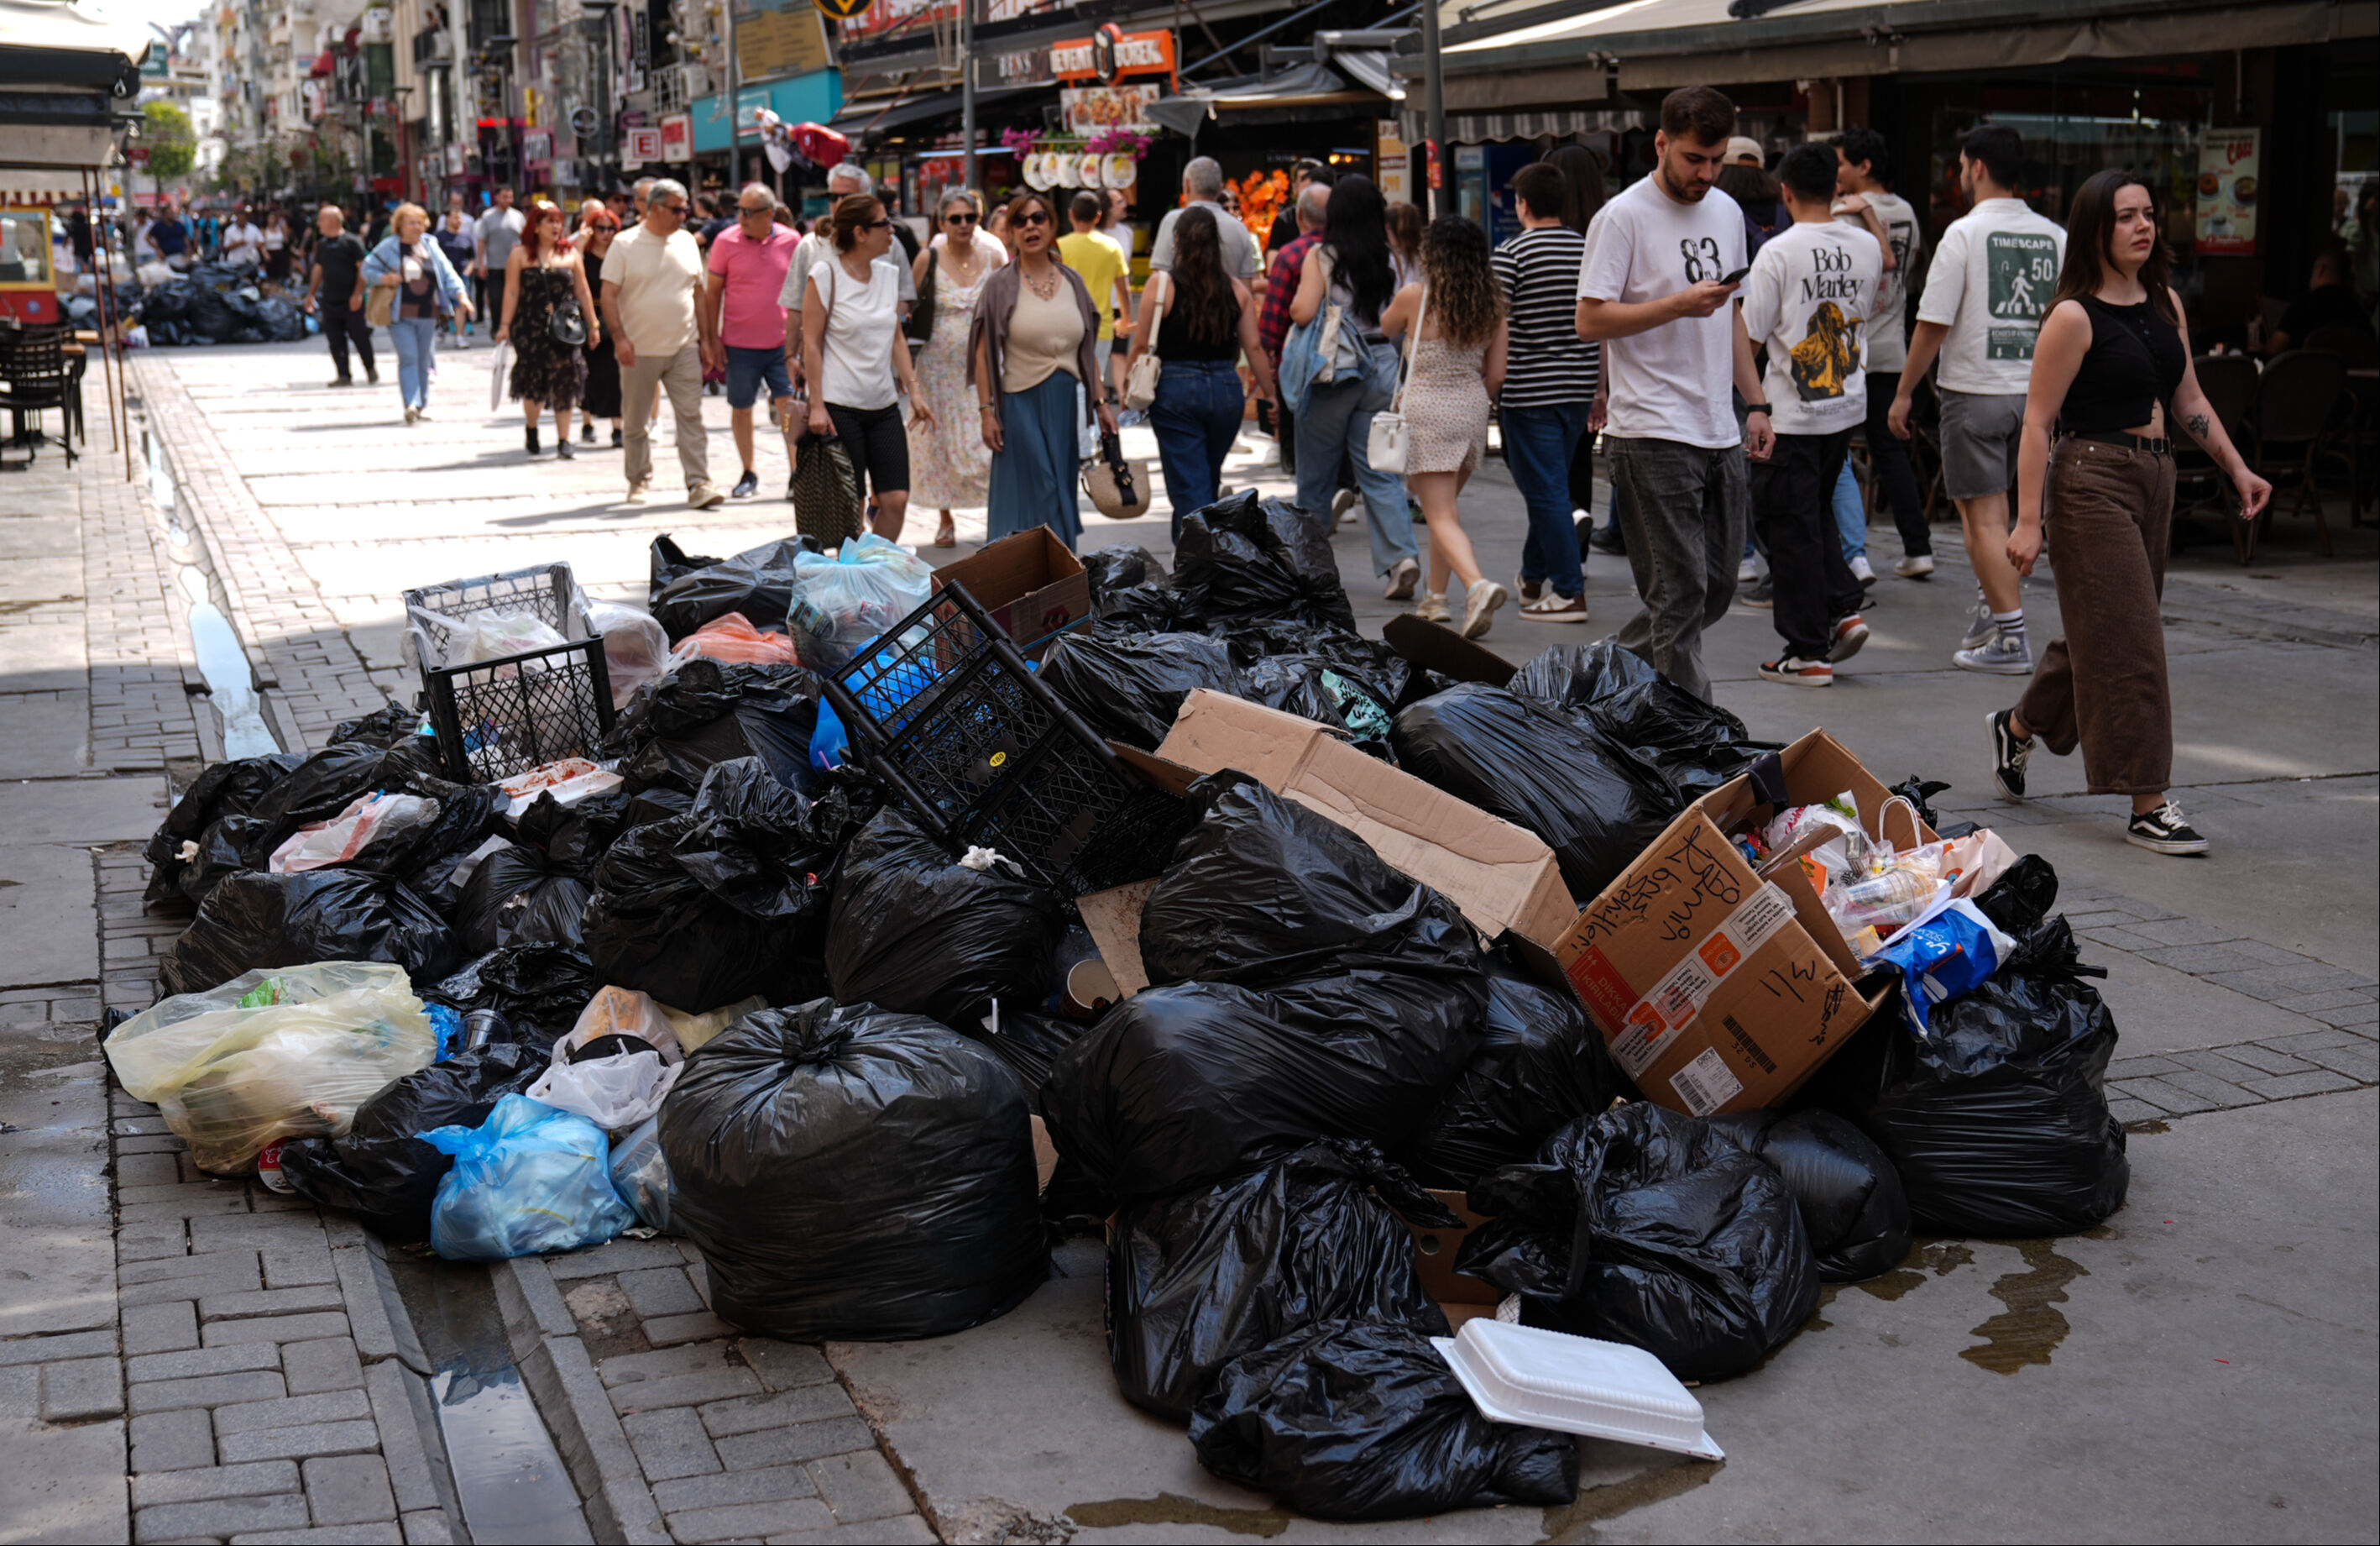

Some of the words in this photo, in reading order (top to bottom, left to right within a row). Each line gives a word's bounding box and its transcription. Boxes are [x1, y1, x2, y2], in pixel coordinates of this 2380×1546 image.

[638, 137, 651, 153] E
[1992, 238, 2053, 250] TIMESCAPE
[1681, 237, 1722, 285] 83
[1811, 245, 1852, 273] Bob
[2032, 258, 2053, 281] 50
[1800, 274, 1865, 305] Marley
[991, 752, 1004, 764] 180
[1598, 977, 1629, 1011] DİKKA
[1730, 1040, 1744, 1055] 32
